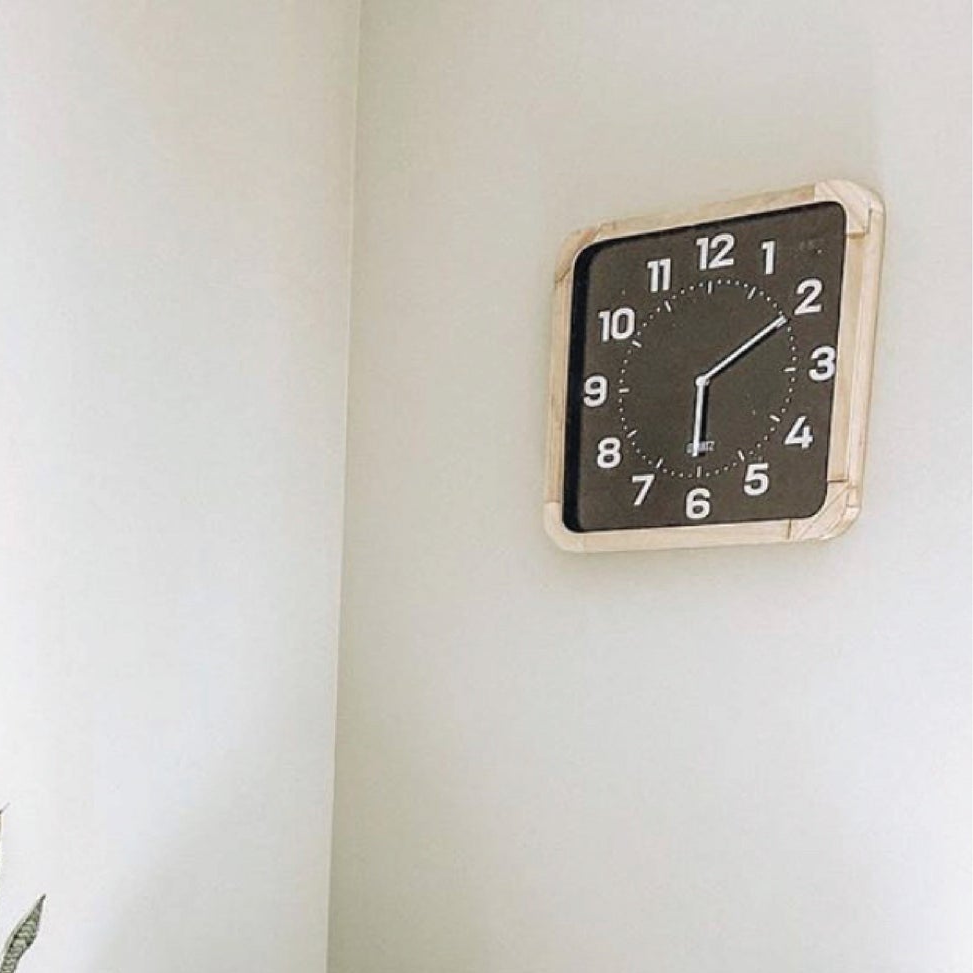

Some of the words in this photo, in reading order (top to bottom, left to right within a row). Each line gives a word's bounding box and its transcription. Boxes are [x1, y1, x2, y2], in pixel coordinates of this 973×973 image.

[696, 234, 735, 270] 12
[761, 240, 776, 275] 1
[647, 258, 671, 292] 11
[794, 278, 823, 315] 2
[598, 307, 636, 342] 10
[808, 346, 836, 381] 3
[583, 375, 608, 407] 9
[785, 416, 814, 448] 4
[596, 437, 621, 468] 8
[632, 474, 655, 506] 7
[744, 463, 769, 496] 5
[685, 487, 711, 519] 6
